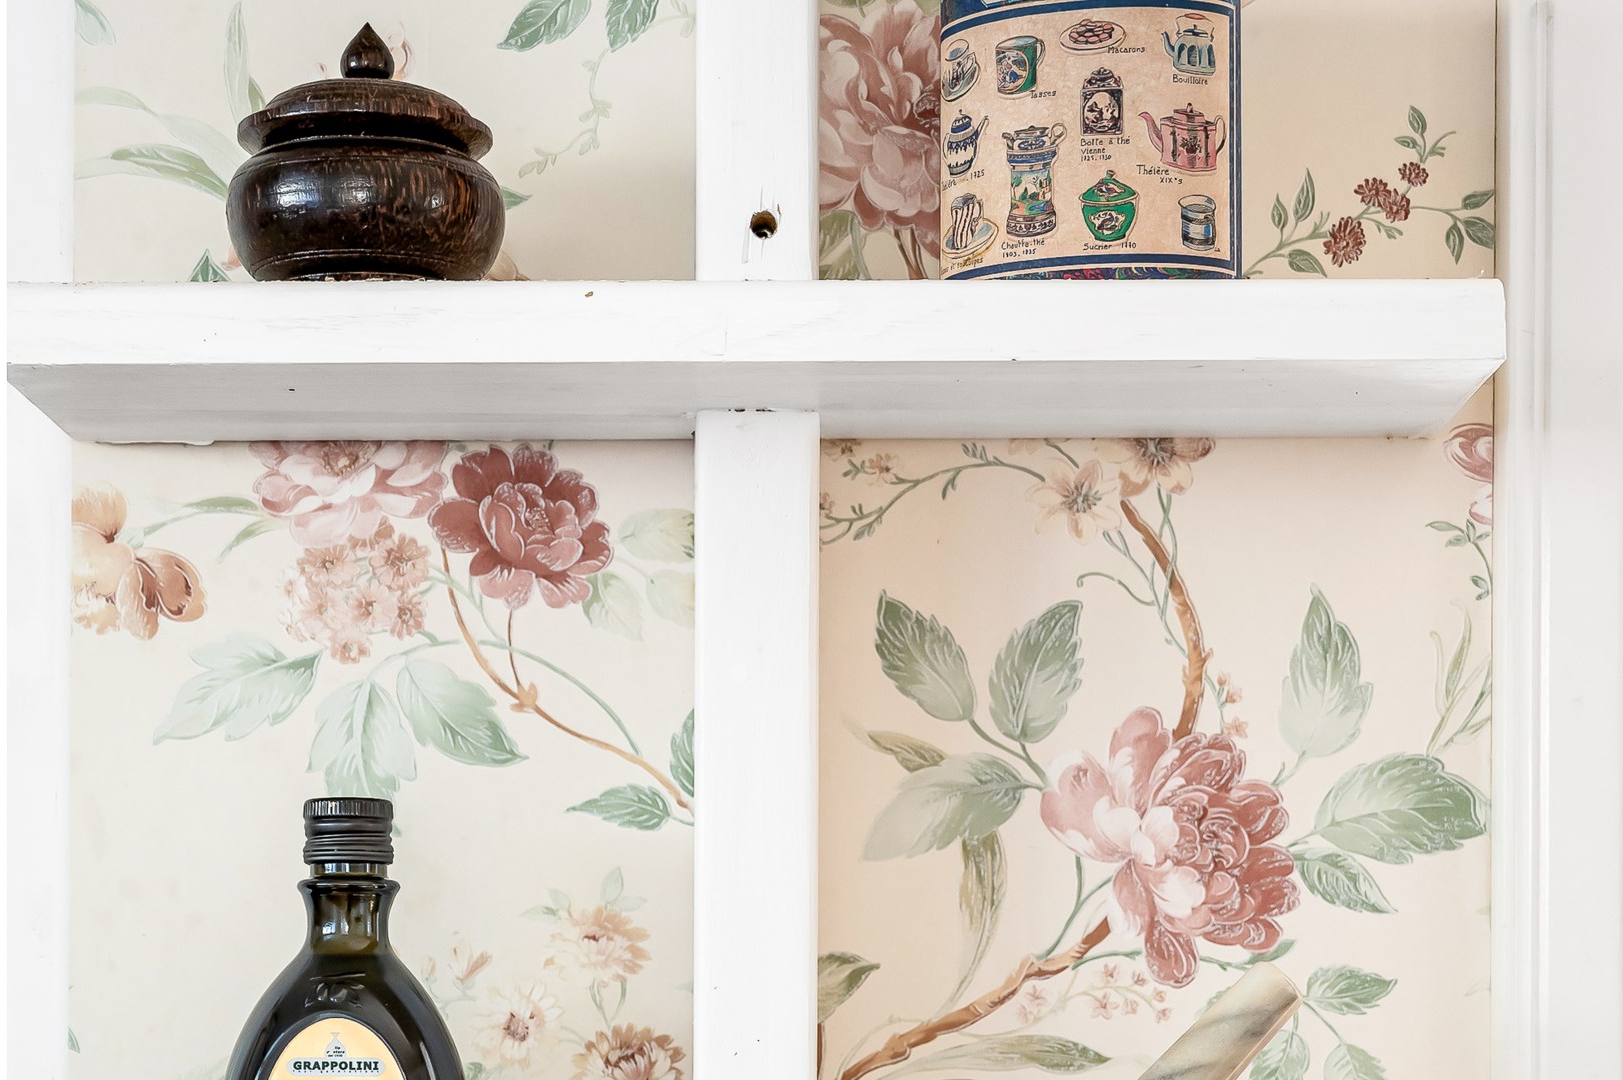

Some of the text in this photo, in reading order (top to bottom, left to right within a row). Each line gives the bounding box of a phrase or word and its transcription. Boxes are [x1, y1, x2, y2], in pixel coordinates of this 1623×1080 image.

[1107, 46, 1145, 54] Macarons
[1029, 89, 1057, 99] Tasses
[1117, 135, 1131, 145] thé
[1083, 242, 1112, 251] Sucrier
[292, 1061, 379, 1071] GRAPPOLINI
